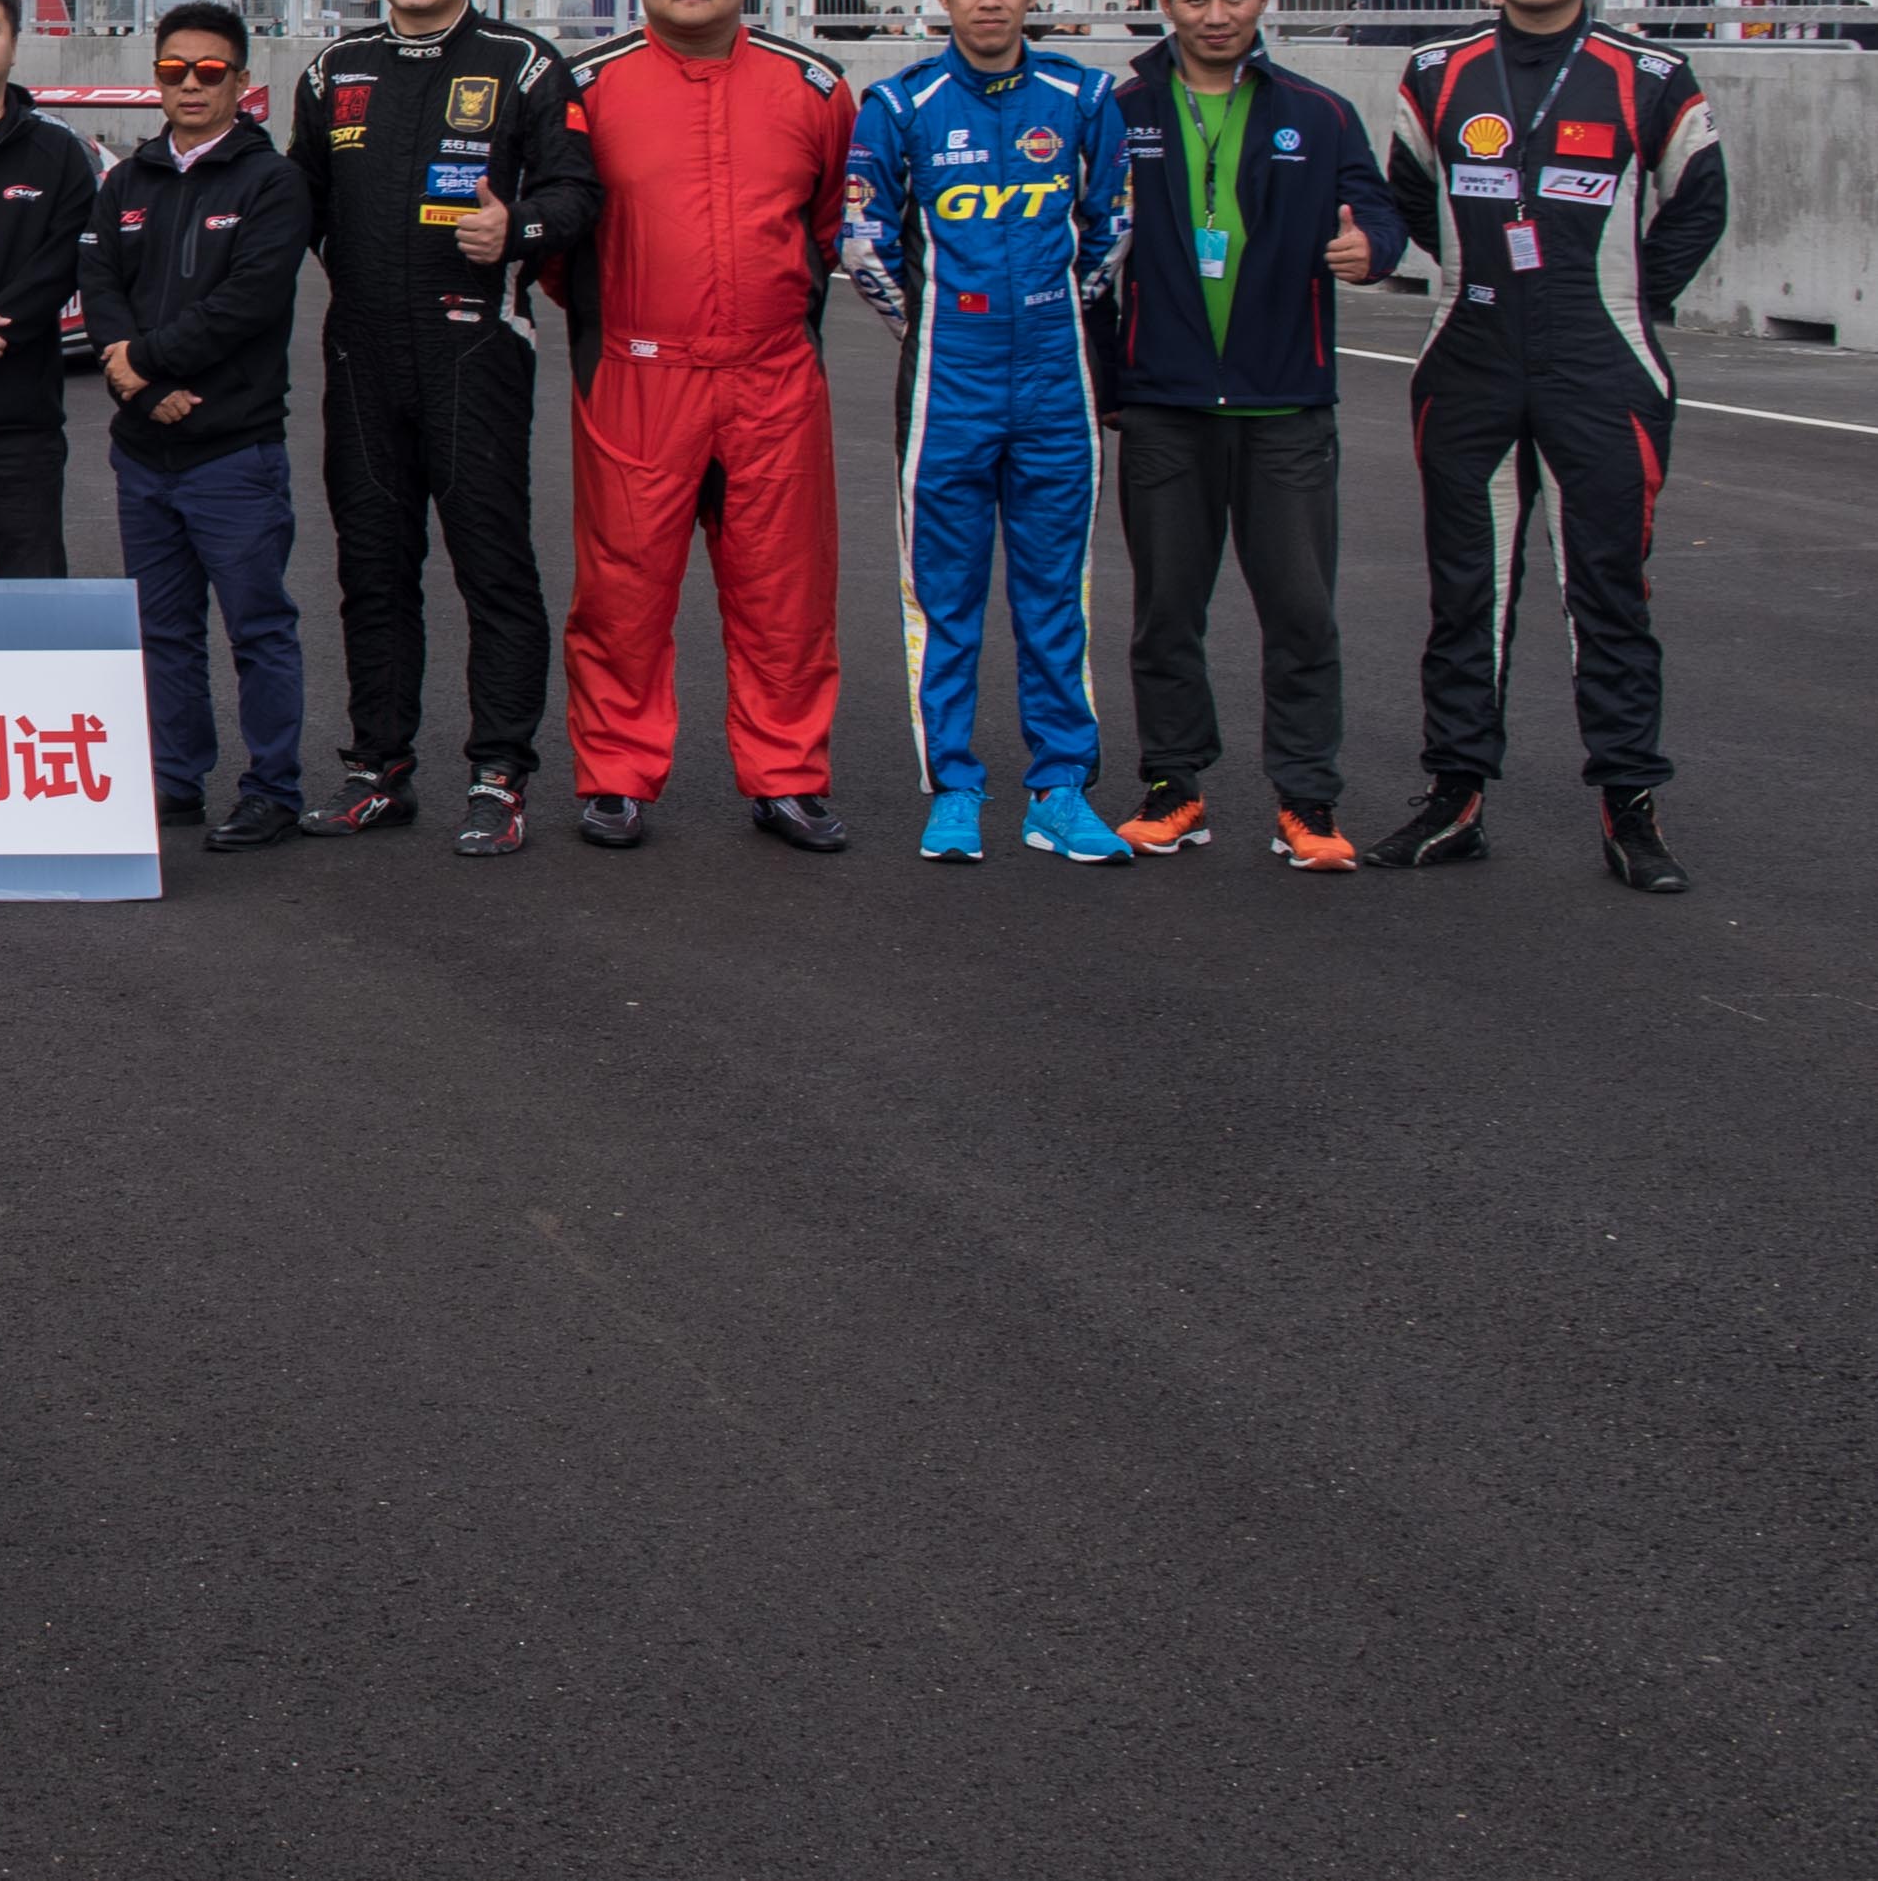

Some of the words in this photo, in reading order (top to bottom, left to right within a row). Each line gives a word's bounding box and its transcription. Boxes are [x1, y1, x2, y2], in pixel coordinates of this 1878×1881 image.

[399, 46, 442, 57] sparco
[806, 68, 834, 93] OMP
[1548, 174, 1601, 194] F4
[936, 183, 1058, 220] GYT
[630, 342, 658, 355] OMP
